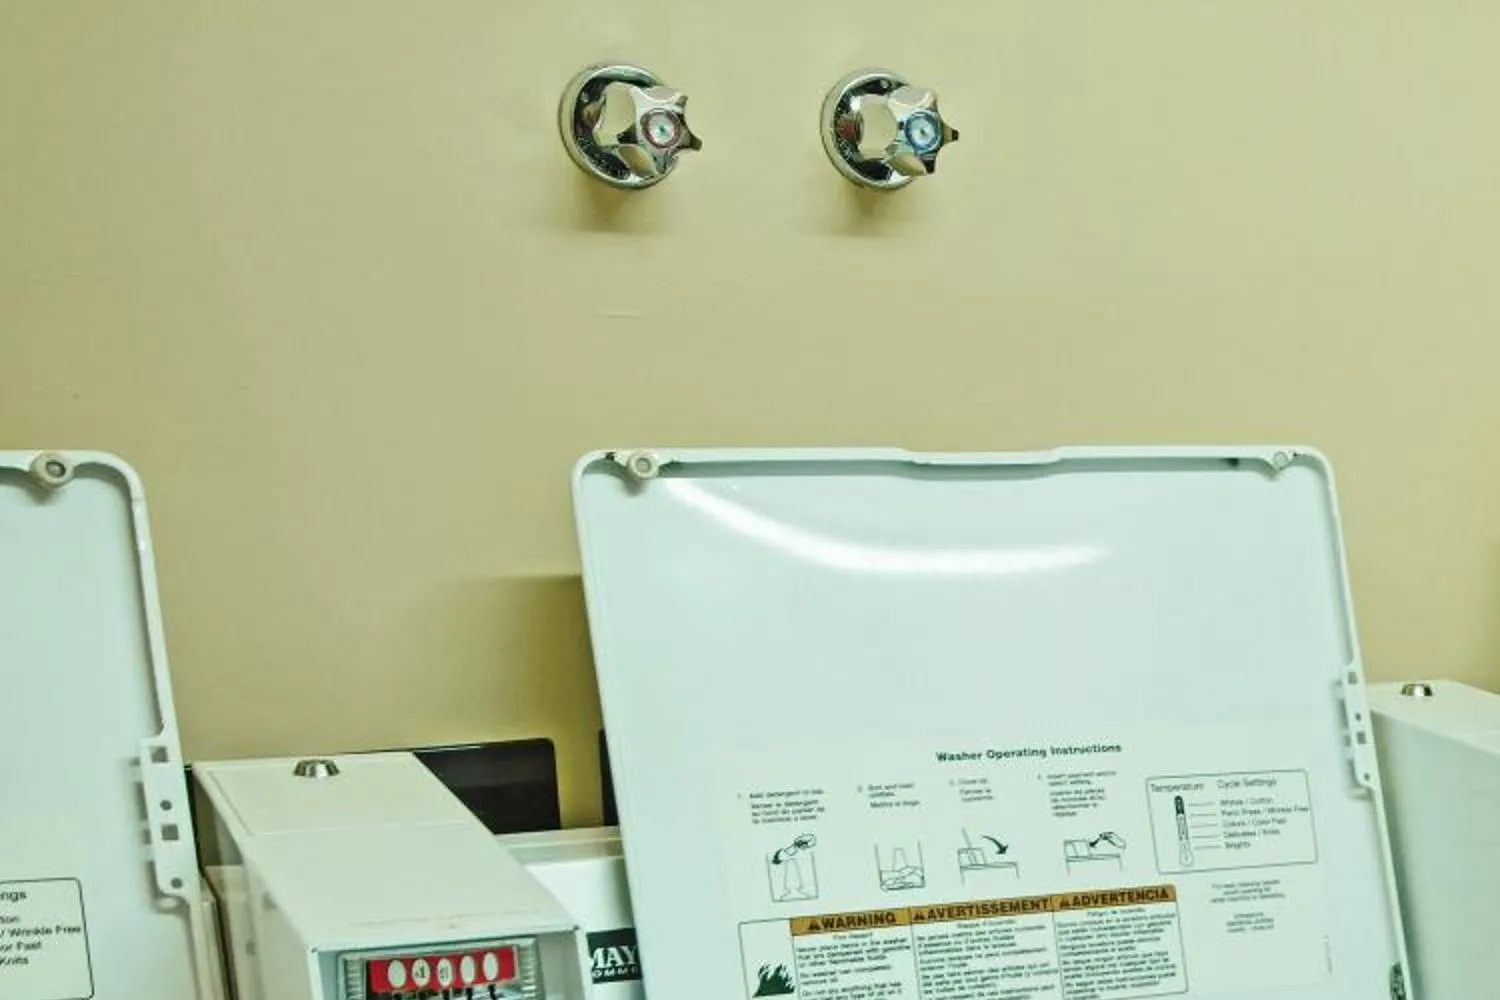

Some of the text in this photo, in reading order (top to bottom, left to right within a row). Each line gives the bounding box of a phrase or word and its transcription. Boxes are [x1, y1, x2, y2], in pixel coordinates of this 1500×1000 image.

[936, 743, 1122, 763] Washer Operating Instructions
[1150, 776, 1277, 793] Temperature Cycle Settings
[1072, 887, 1170, 907] ADVERTENCIA
[927, 898, 1050, 919] AVERTISSEMENT
[821, 911, 898, 930] WARNING
[9, 927, 53, 938] Wrinkle
[55, 924, 81, 935] Free
